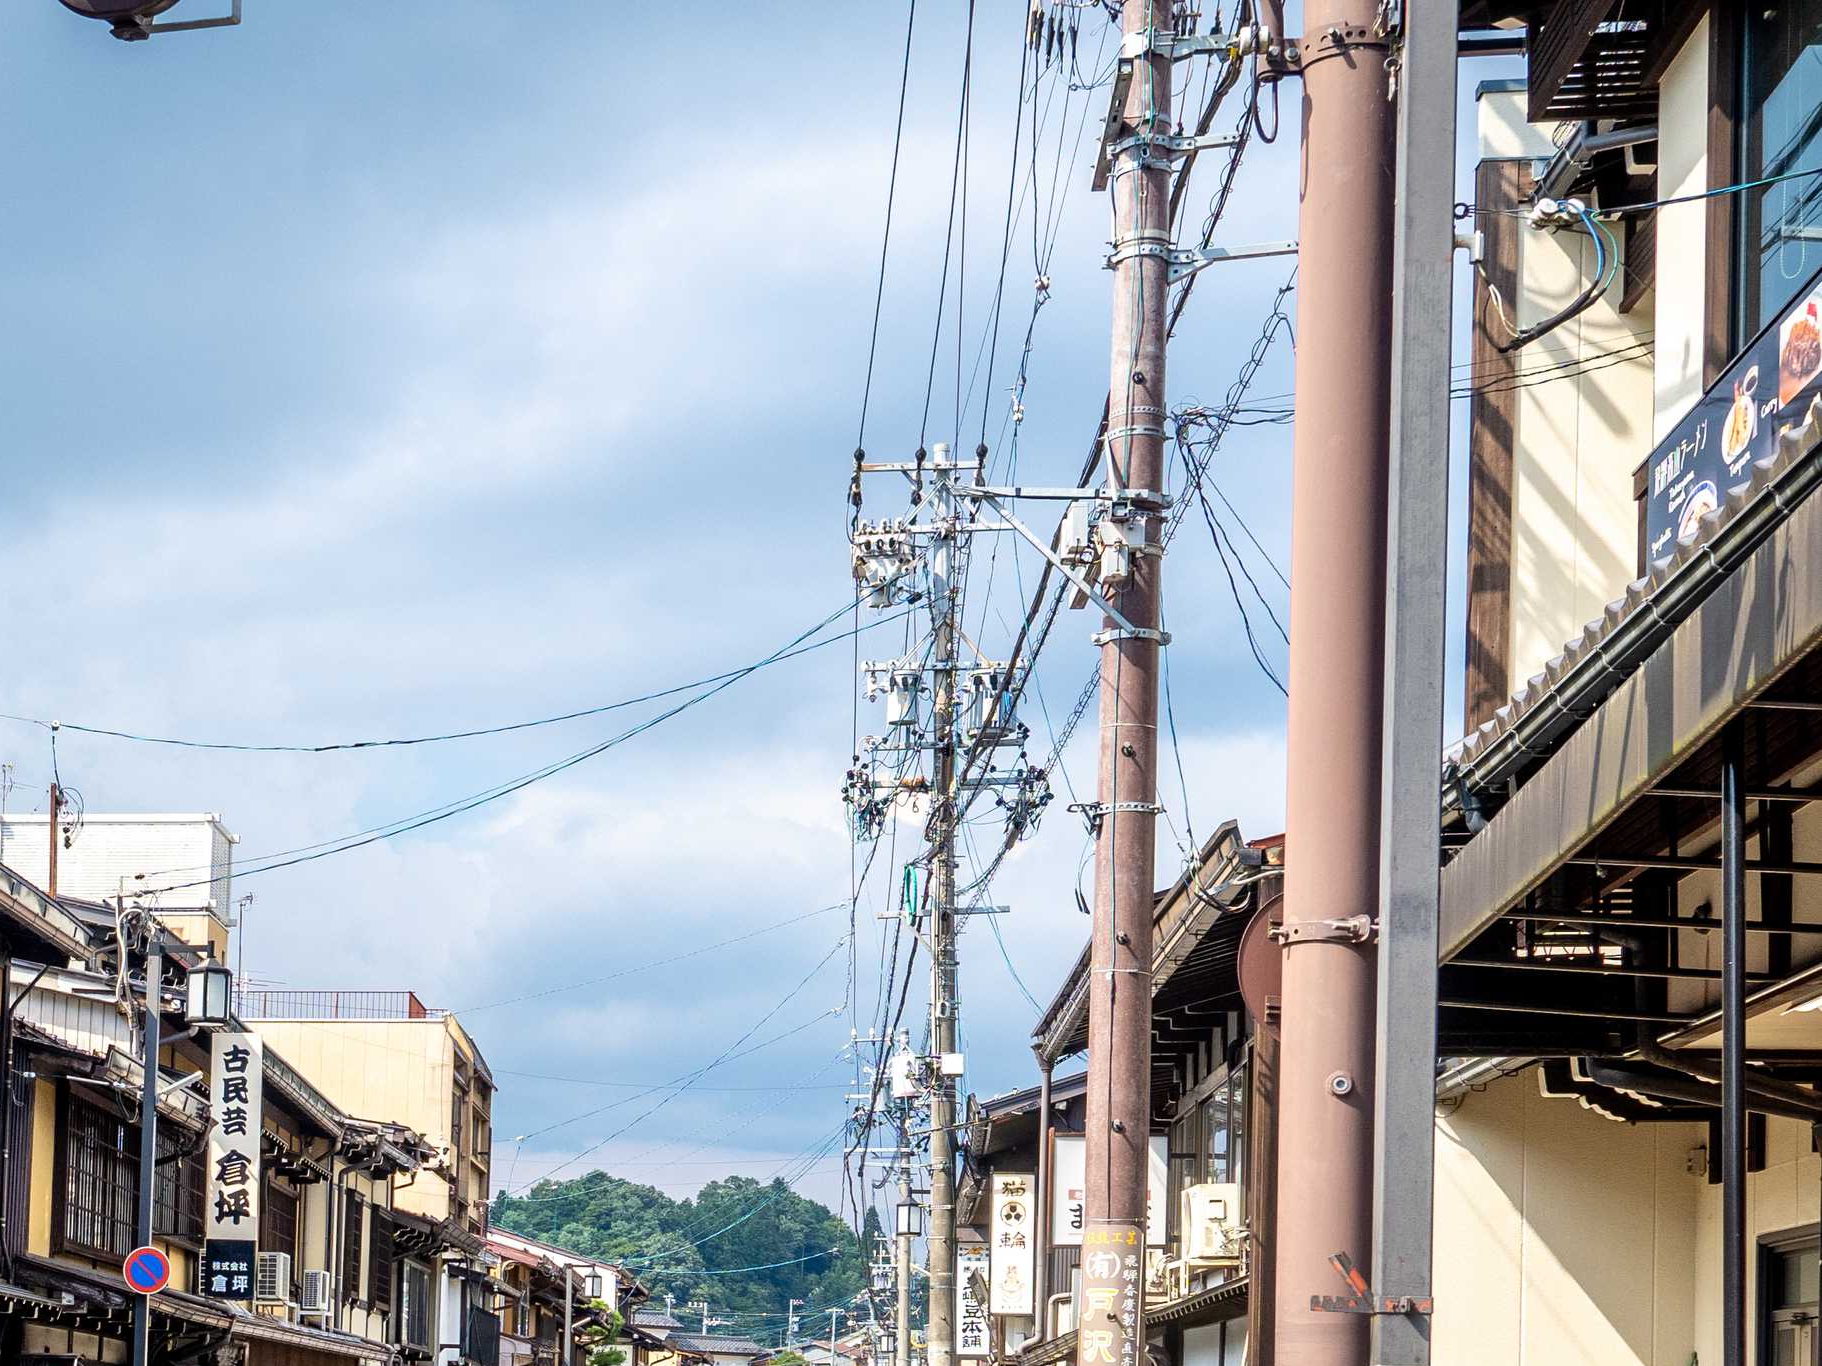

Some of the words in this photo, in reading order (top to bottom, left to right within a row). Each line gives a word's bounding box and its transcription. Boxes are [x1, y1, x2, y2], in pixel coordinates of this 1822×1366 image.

[222, 1044, 250, 1136] 古民芸
[214, 1149, 252, 1226] 倉坪
[211, 1274, 248, 1293] 倉坪
